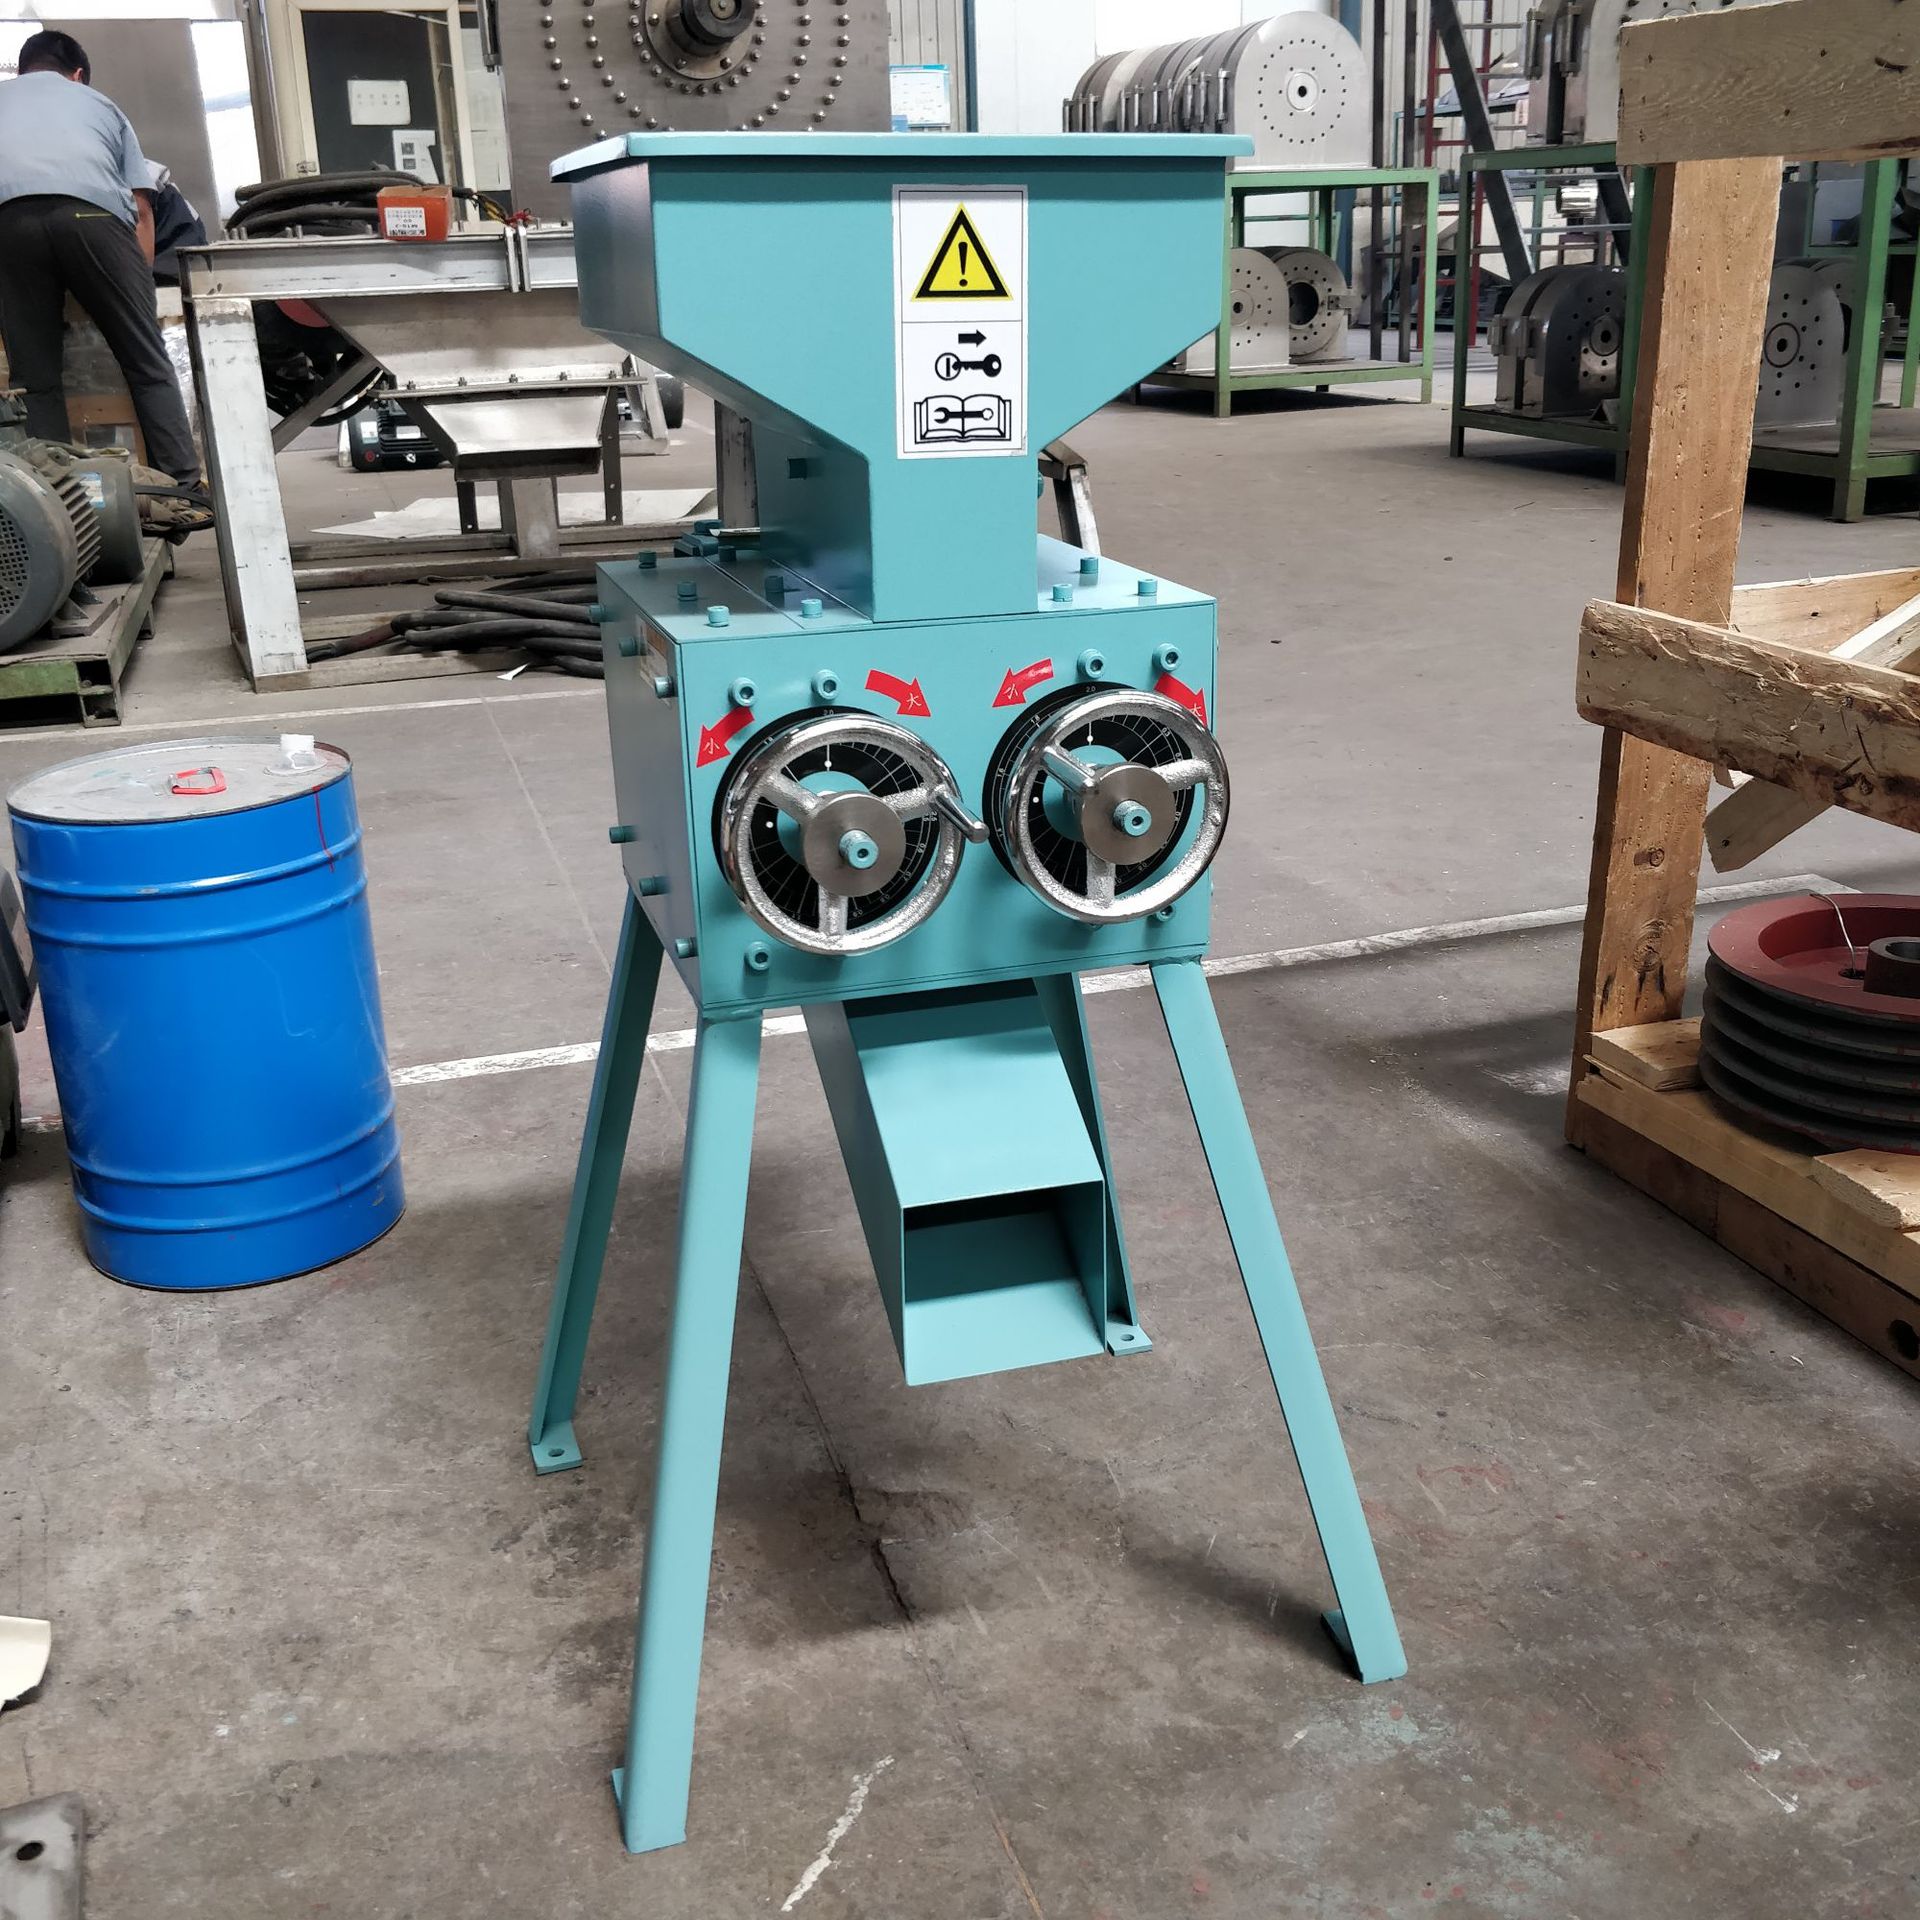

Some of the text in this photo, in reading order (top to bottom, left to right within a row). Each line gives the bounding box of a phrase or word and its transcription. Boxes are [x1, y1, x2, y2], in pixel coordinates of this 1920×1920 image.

[907, 692, 923, 709] 大
[1004, 684, 1019, 700] 小
[704, 737, 721, 755] 小
